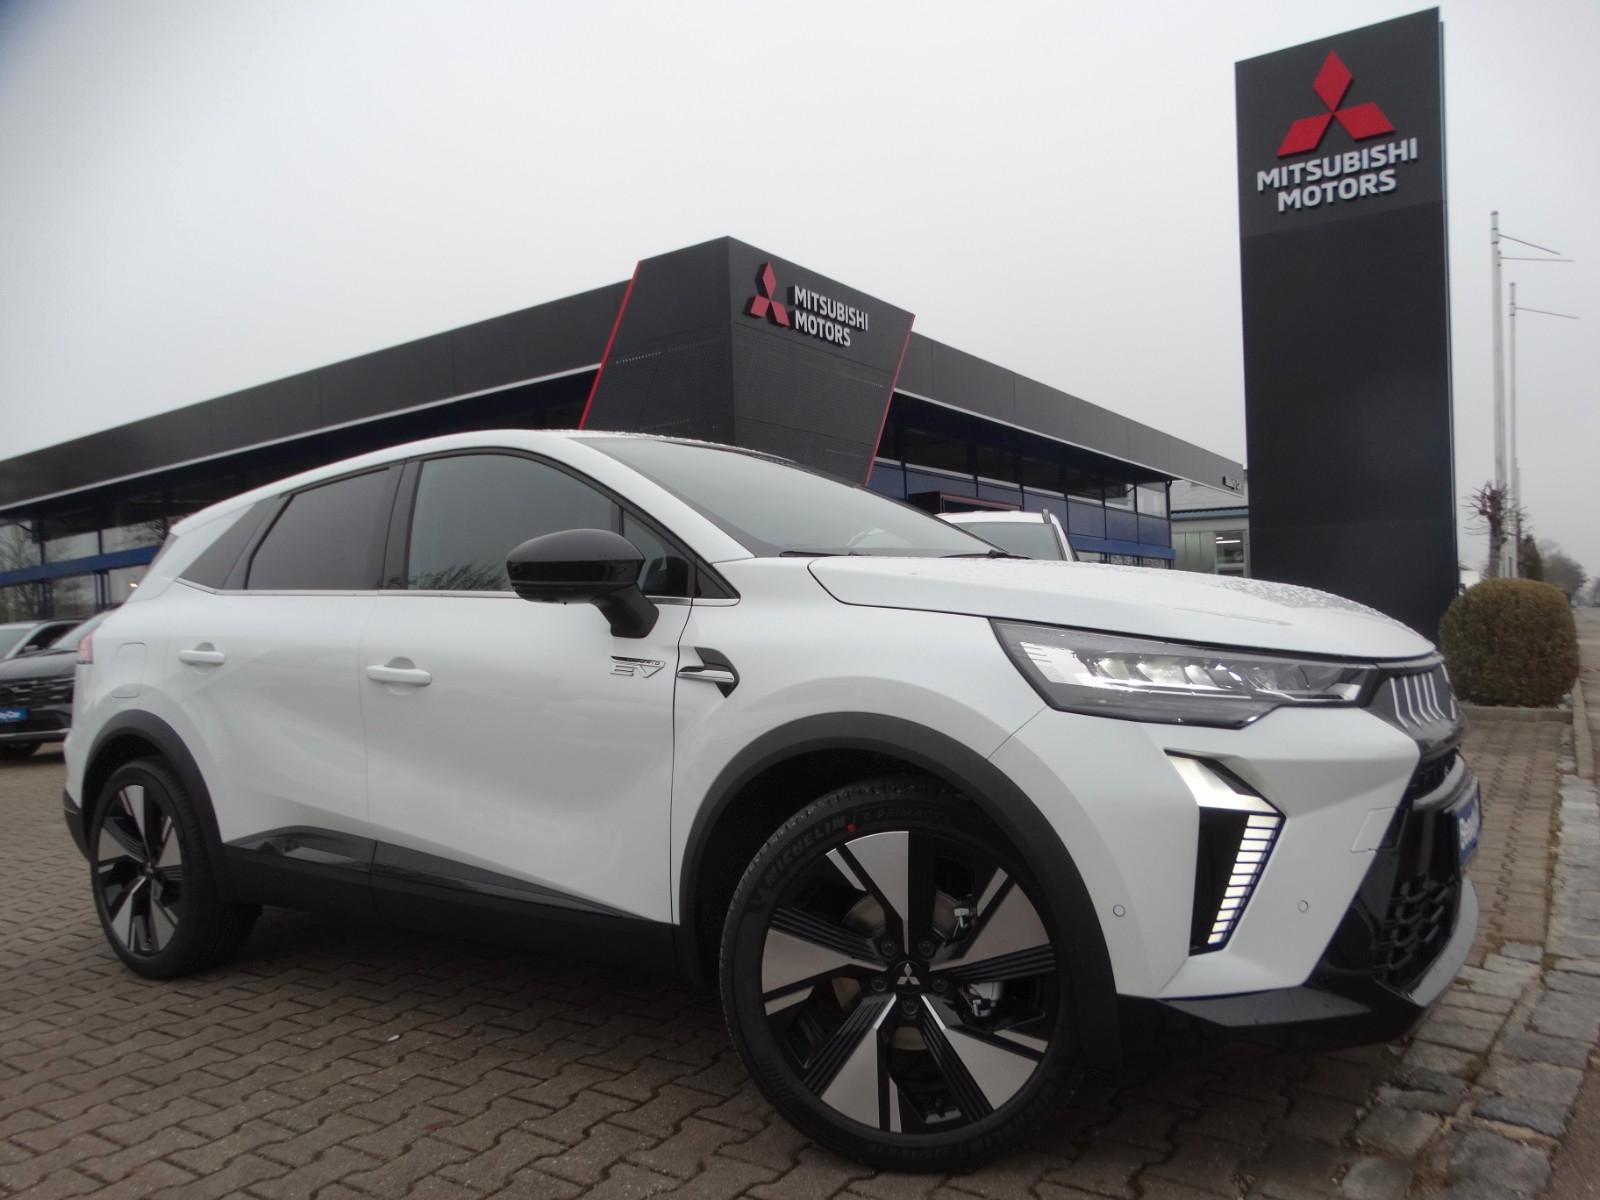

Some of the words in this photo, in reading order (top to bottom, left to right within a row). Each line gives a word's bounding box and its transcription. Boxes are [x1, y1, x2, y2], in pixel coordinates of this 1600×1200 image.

[1256, 137, 1418, 192] MITSUBISHI
[1277, 168, 1397, 213] MOTORS
[794, 284, 869, 331] MITSUBISHI
[794, 309, 851, 347] MOTORS
[764, 815, 846, 887] MICHELIN
